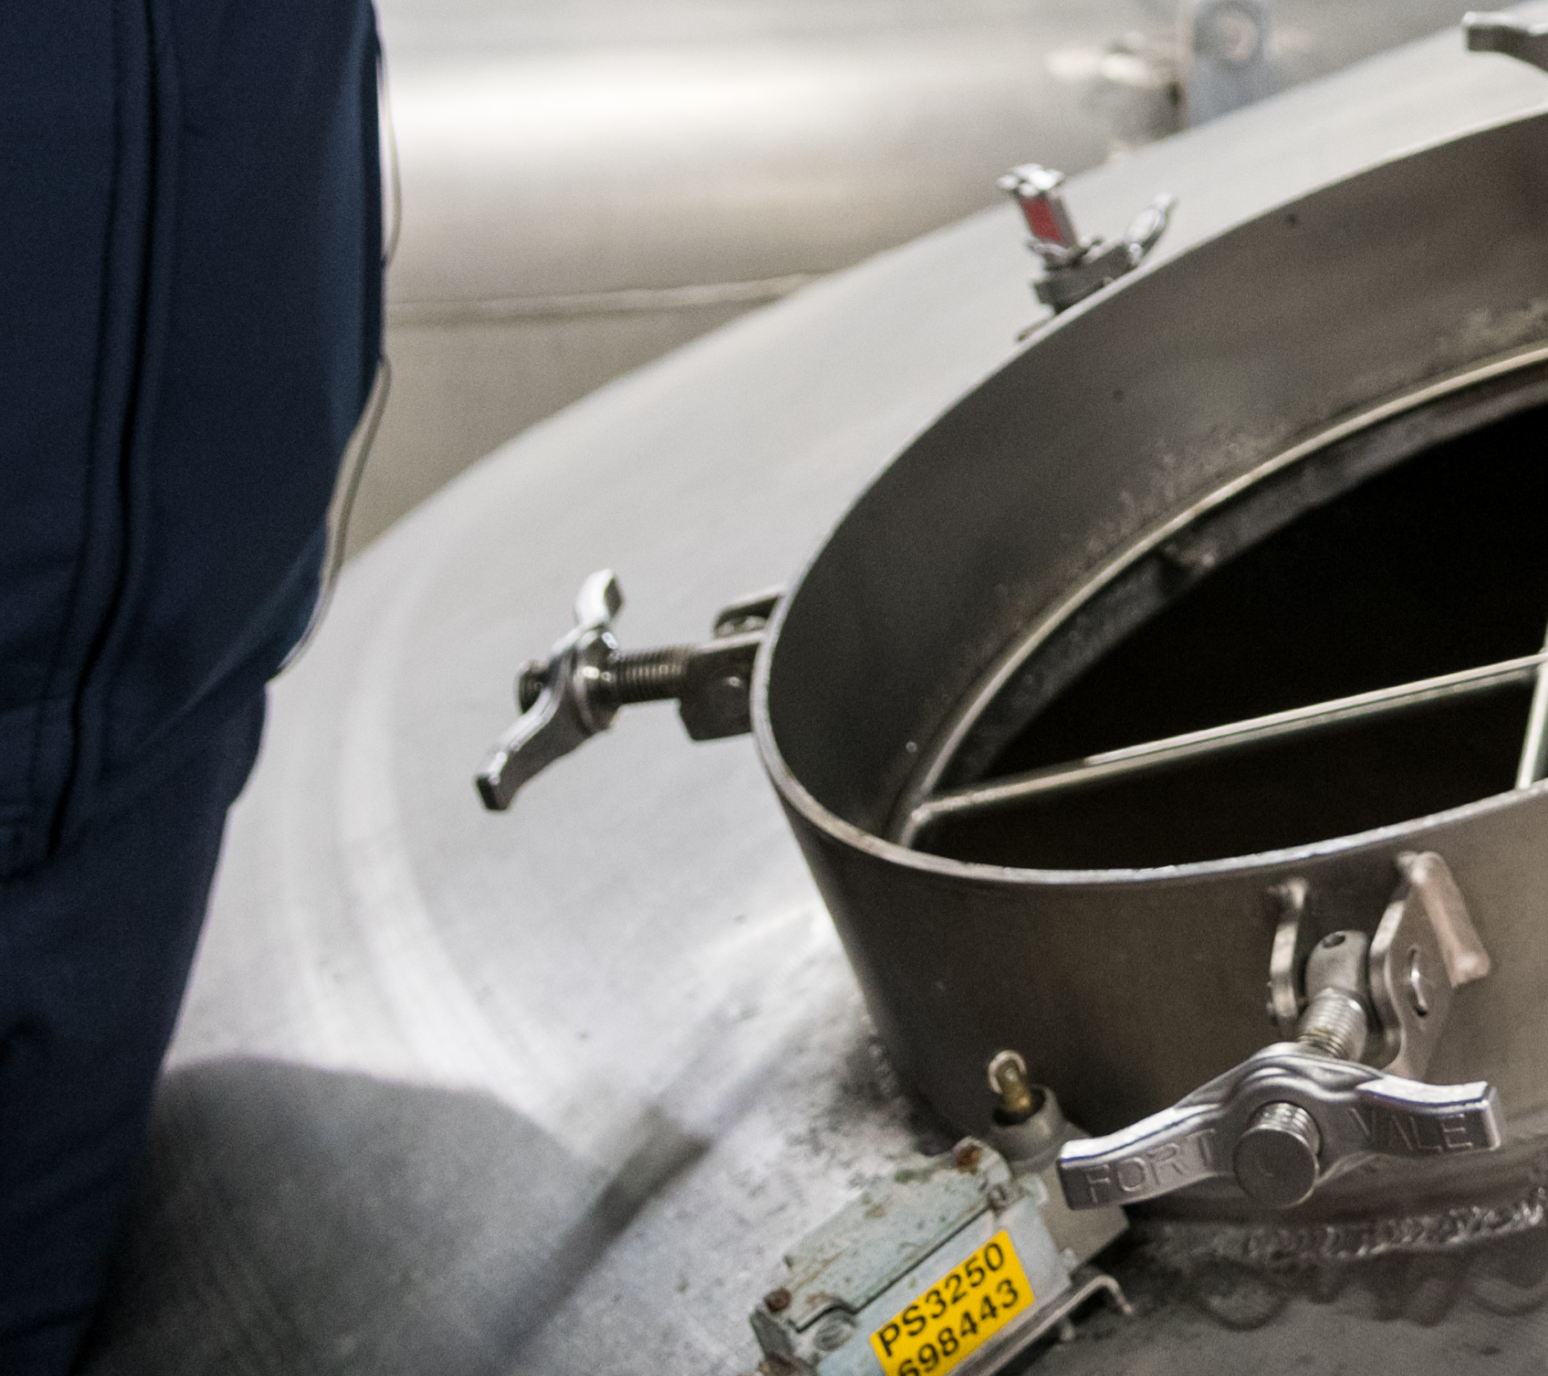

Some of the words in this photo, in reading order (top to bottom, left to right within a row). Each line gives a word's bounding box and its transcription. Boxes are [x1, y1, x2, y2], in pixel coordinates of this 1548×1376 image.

[1084, 1128, 1217, 1205] FORT
[1349, 1109, 1474, 1154] VALE
[878, 1242, 1005, 1358] PS3250
[897, 1279, 1019, 1376] 698443
